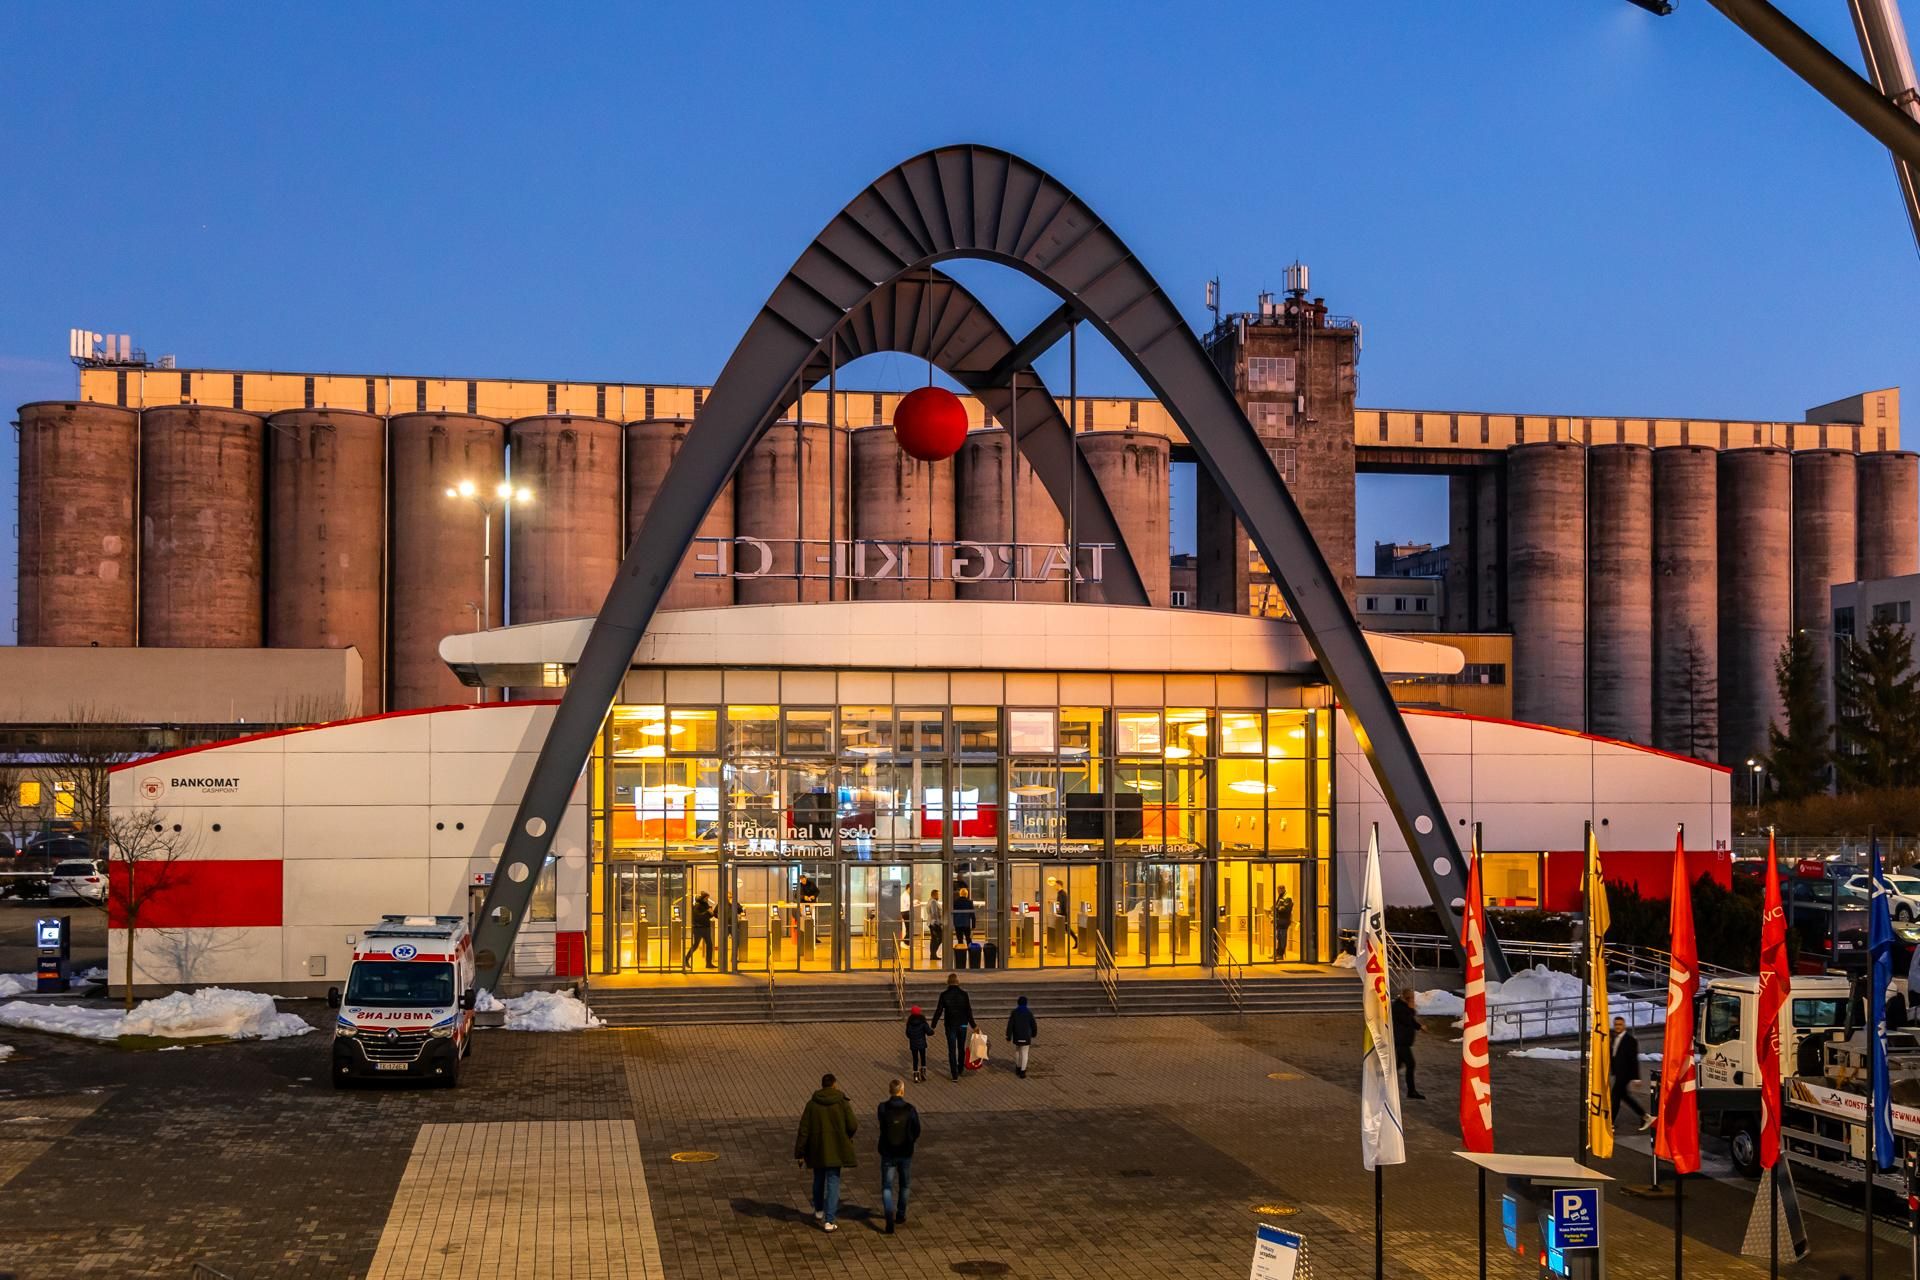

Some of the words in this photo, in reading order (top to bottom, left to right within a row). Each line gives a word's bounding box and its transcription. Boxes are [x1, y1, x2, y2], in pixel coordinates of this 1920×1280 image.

[171, 778, 239, 787] BANKOMAT
[736, 824, 812, 839] Termnal
[1140, 844, 1194, 853] Entrance
[1562, 1195, 1583, 1219] P
